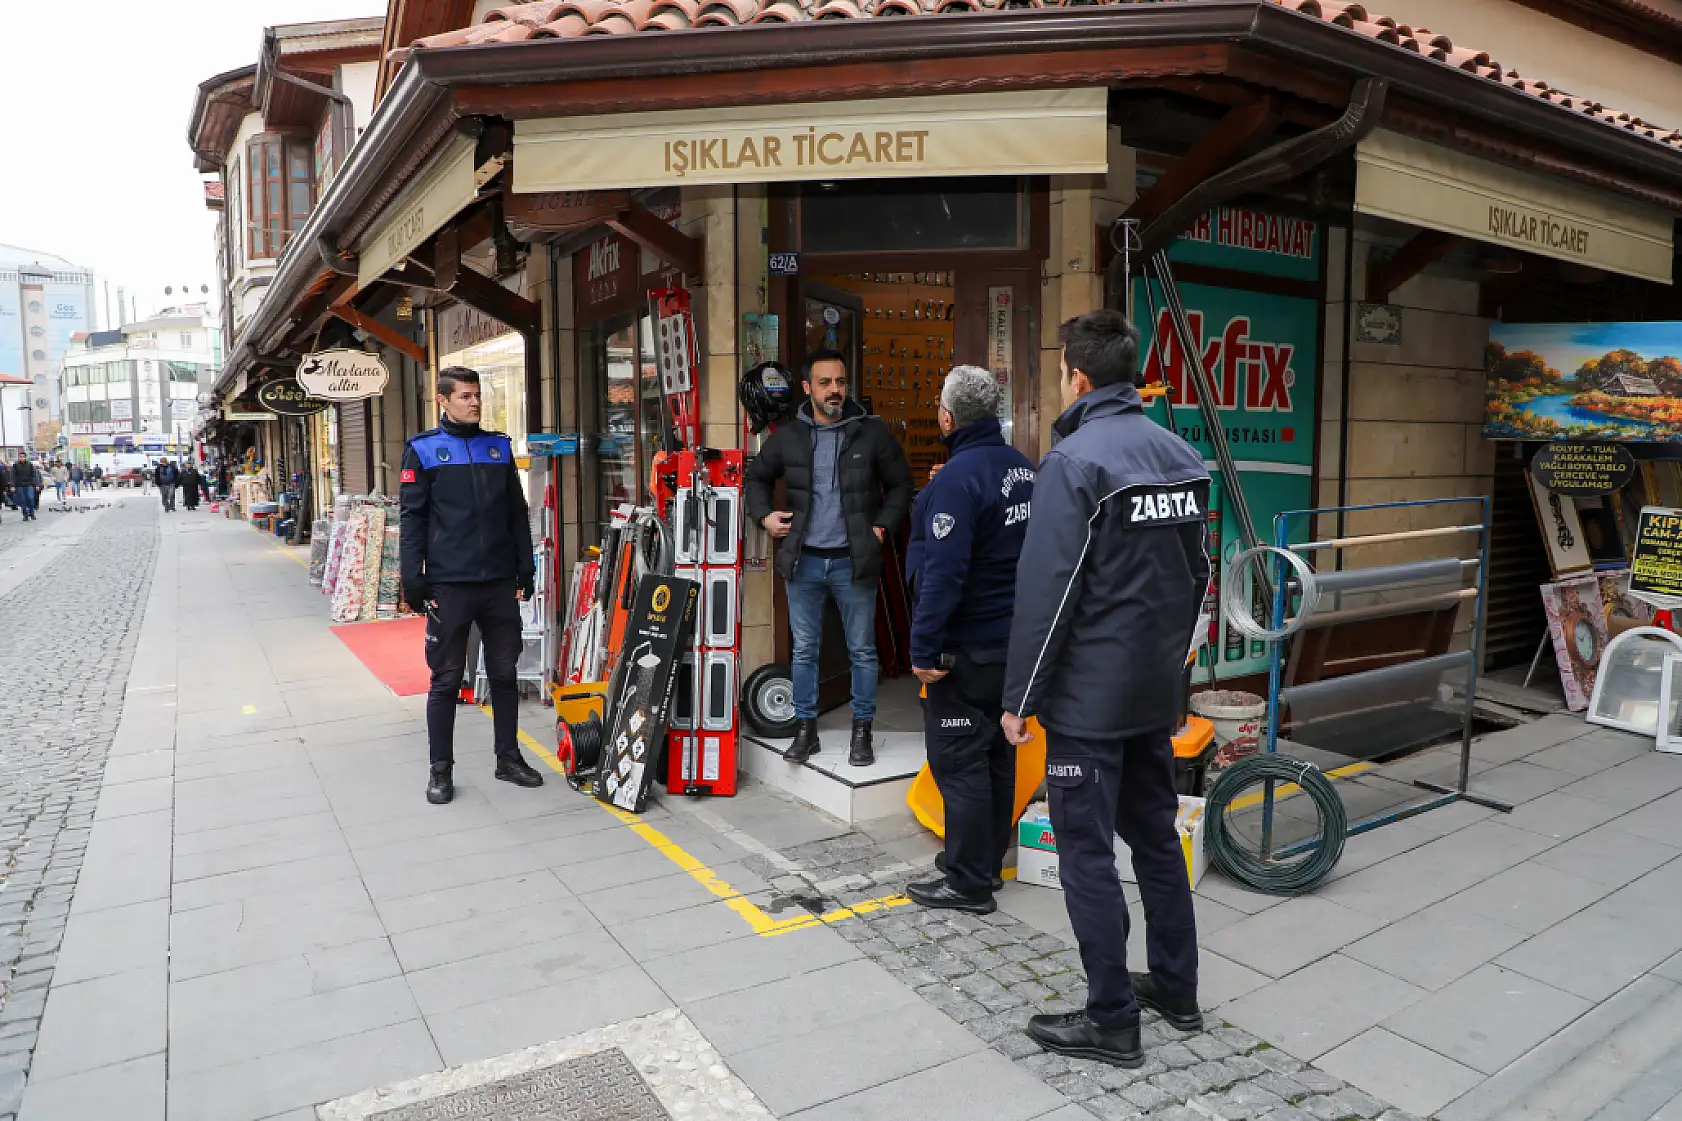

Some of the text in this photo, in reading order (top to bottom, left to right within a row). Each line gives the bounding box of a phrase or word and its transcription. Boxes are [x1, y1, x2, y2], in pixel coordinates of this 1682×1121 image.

[664, 125, 929, 177] IŞIKLAR TİCARET
[1217, 205, 1317, 260] HIRDAVAT
[1488, 205, 1590, 254] IŞIKLAR TİCARET
[769, 255, 798, 272] 62/A
[1141, 306, 1295, 412] Akfix
[1004, 501, 1031, 527] ZABI
[1130, 491, 1200, 522] ZABITA
[940, 717, 972, 728] ZABITA
[1047, 764, 1083, 777] ZABITA
[1038, 830, 1057, 846] Ak
